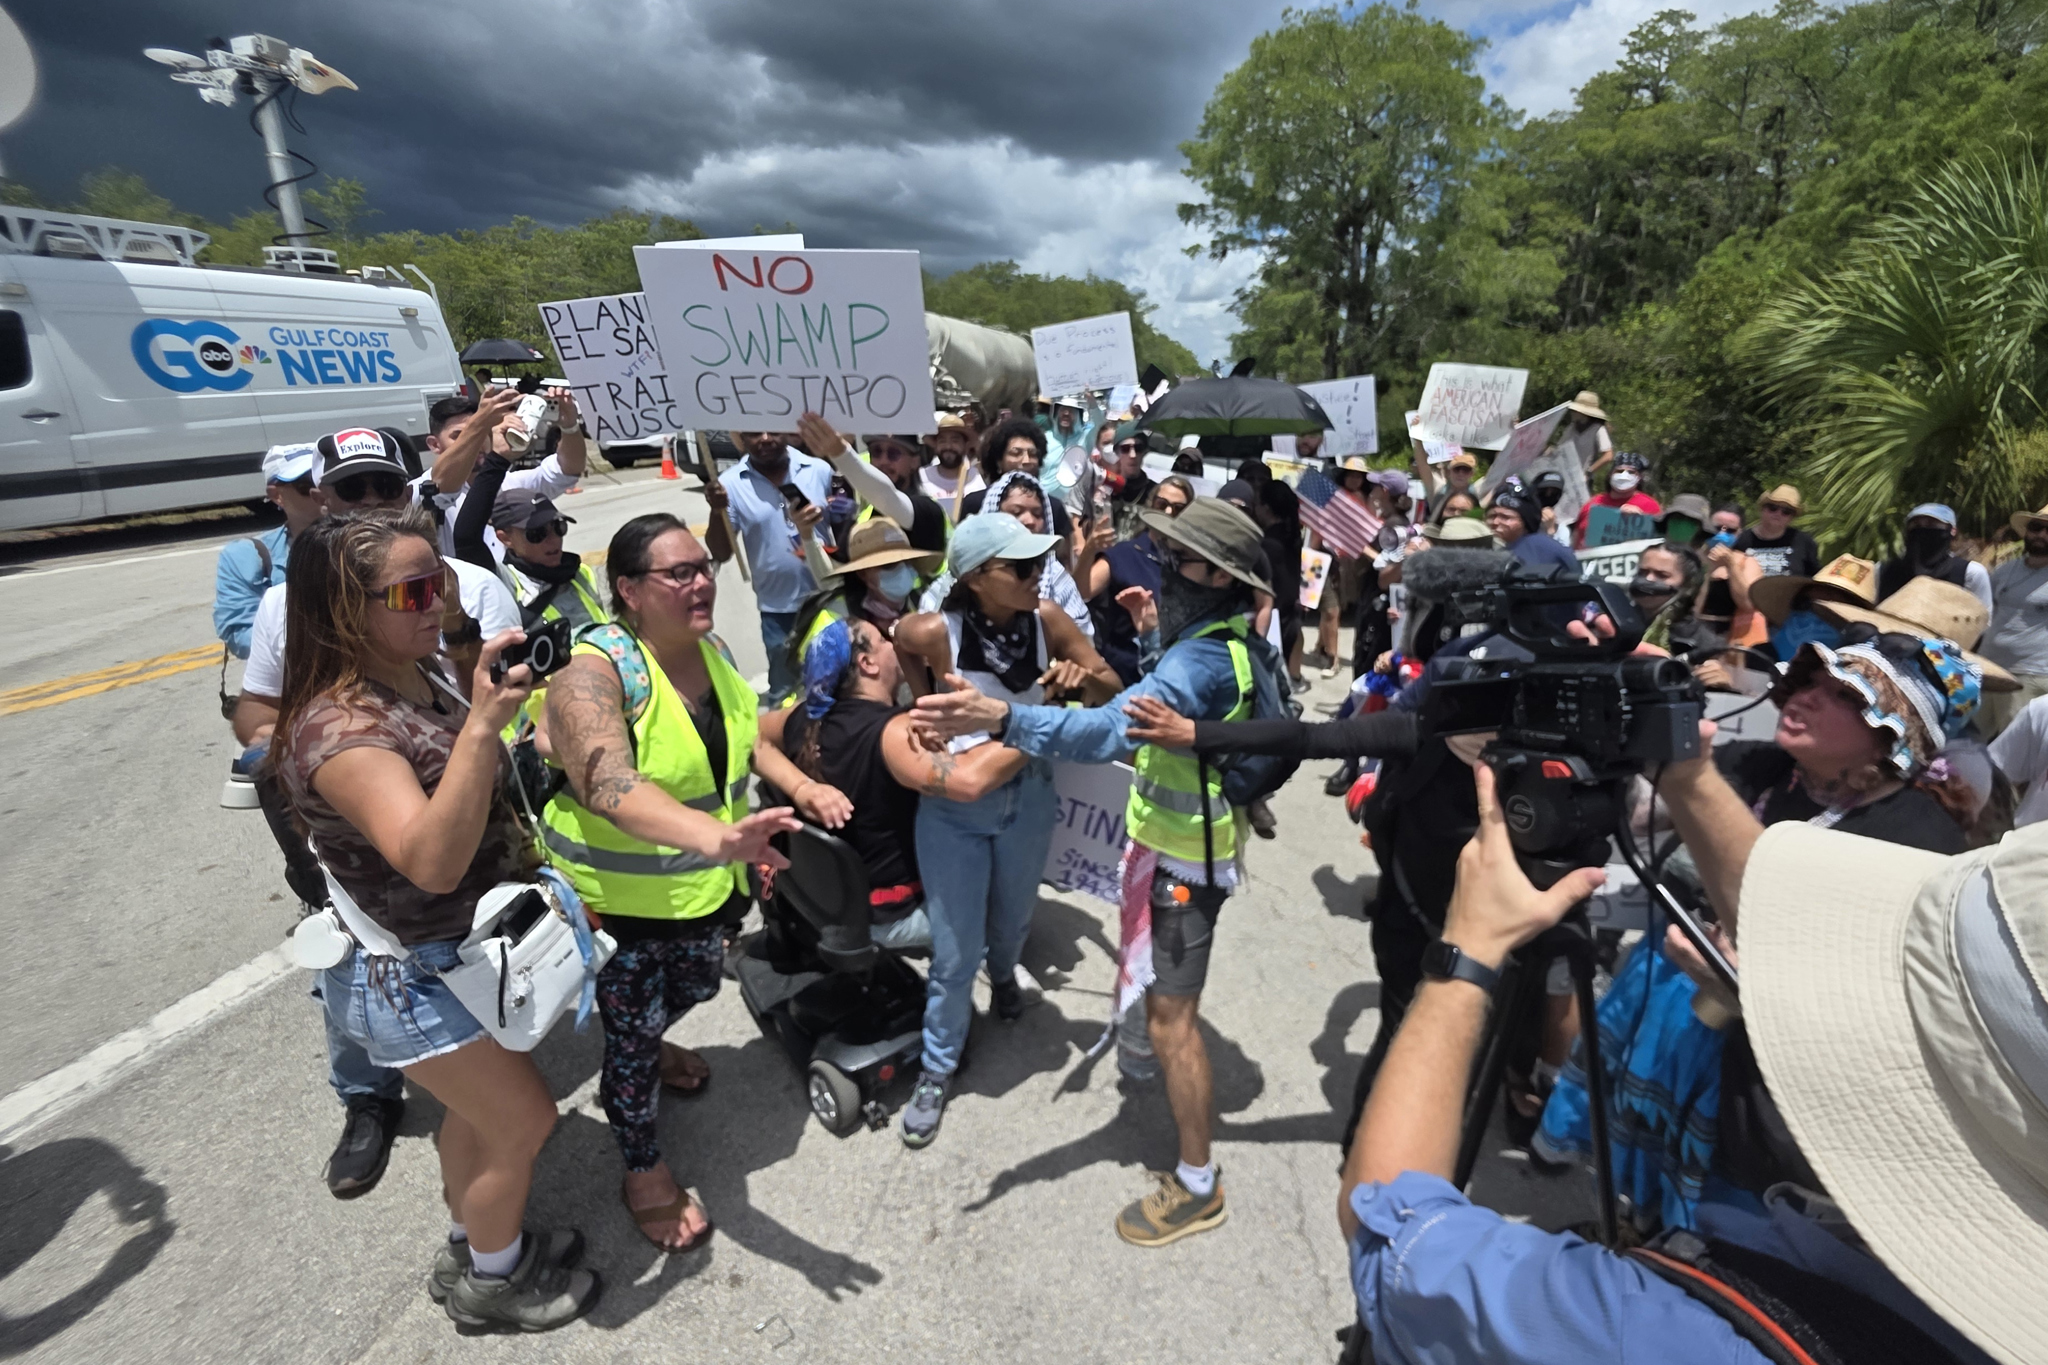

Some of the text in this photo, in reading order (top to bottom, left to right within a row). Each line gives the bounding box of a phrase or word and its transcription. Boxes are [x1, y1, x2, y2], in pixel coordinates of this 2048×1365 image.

[713, 253, 814, 295] NO
[269, 326, 390, 348] GULF COAST
[554, 333, 606, 361] EL
[683, 302, 890, 369] SWAMP
[1035, 325, 1116, 346] Due Process
[202, 349, 232, 362] abc
[276, 349, 403, 386] NEWS
[572, 374, 676, 413] TRAI
[696, 371, 907, 419] GESTAPO
[1481, 372, 1512, 393] what
[1430, 386, 1503, 410] AMERICAN
[596, 405, 684, 442] AUSC
[1428, 404, 1503, 429] FASCISM
[340, 442, 383, 455] Explore
